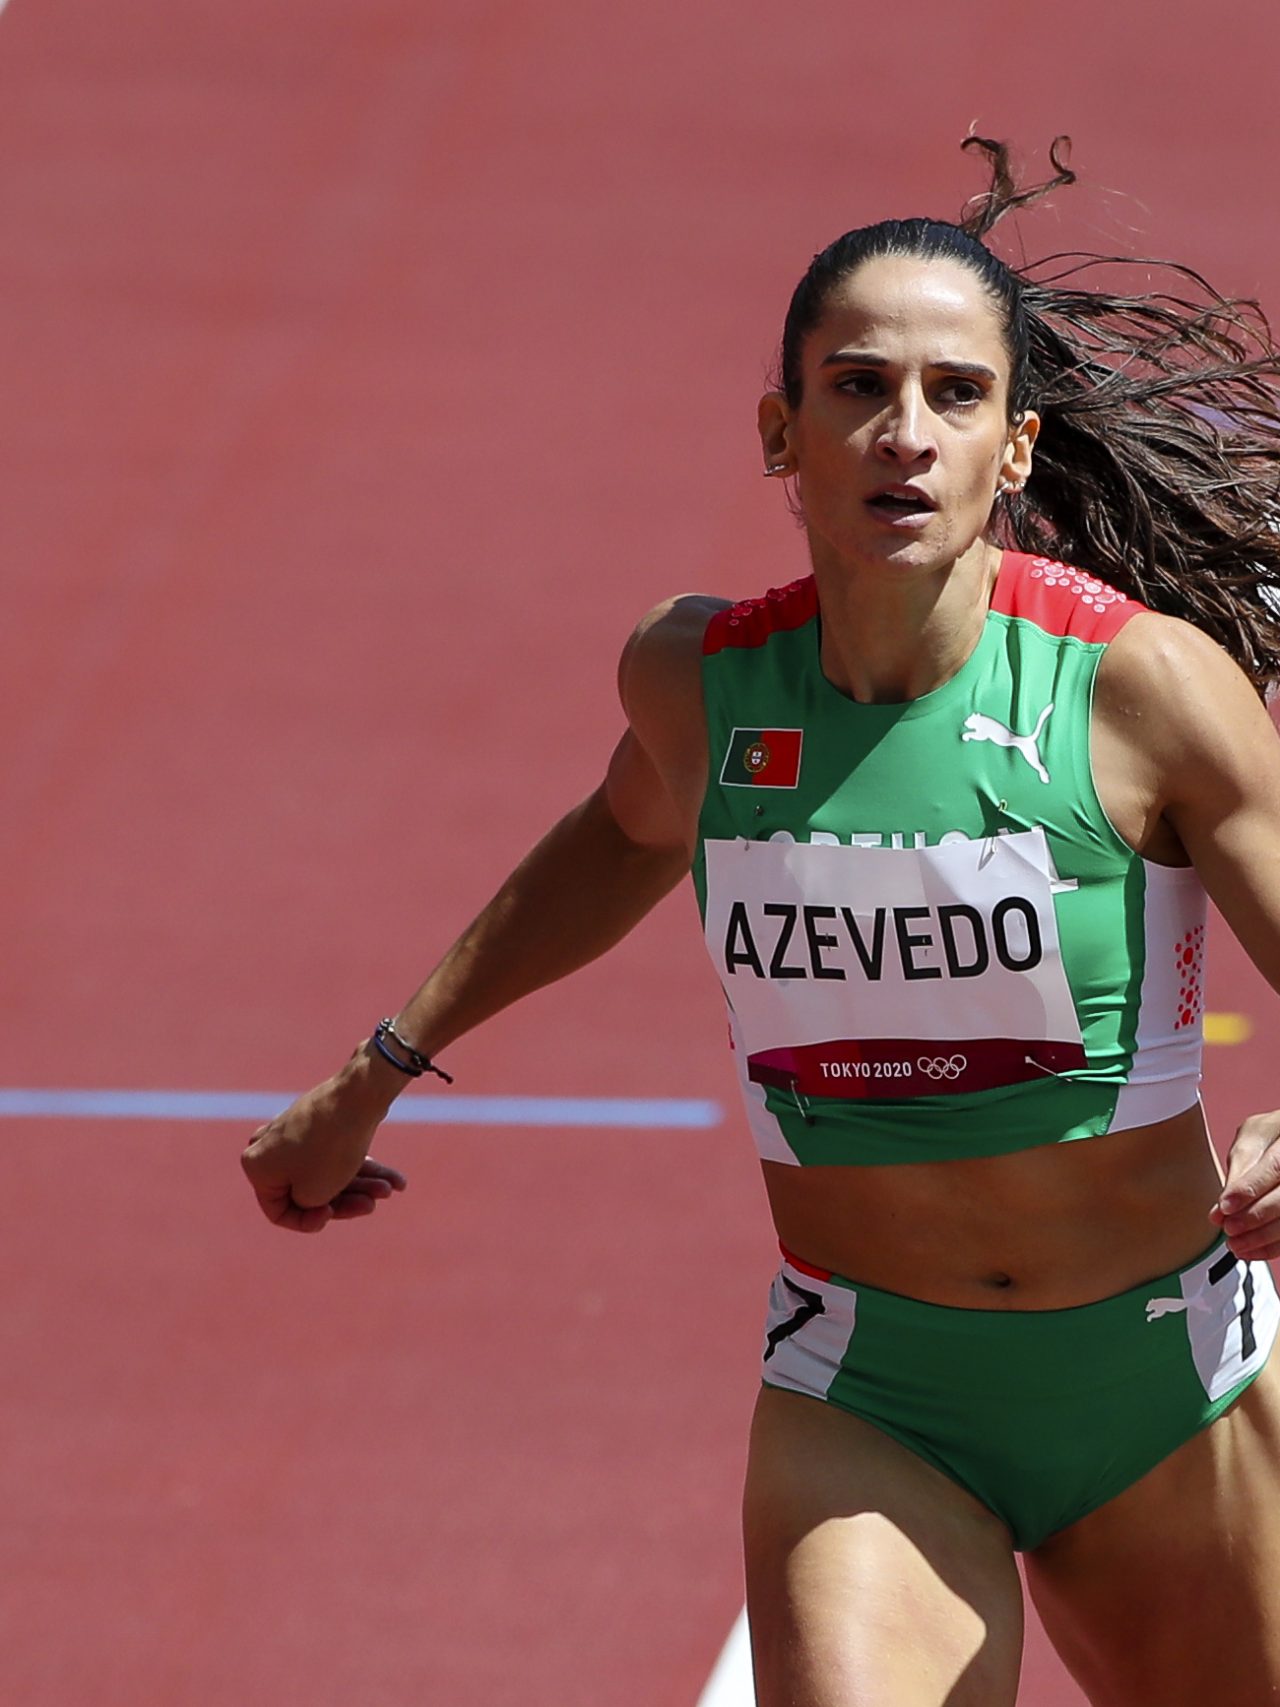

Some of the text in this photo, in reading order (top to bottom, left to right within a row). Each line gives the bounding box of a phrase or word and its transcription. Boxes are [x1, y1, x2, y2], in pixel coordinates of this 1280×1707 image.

[724, 896, 1043, 981] AZEVEDO
[819, 1061, 913, 1078] TOKYO 2020
[763, 1270, 826, 1363] 7
